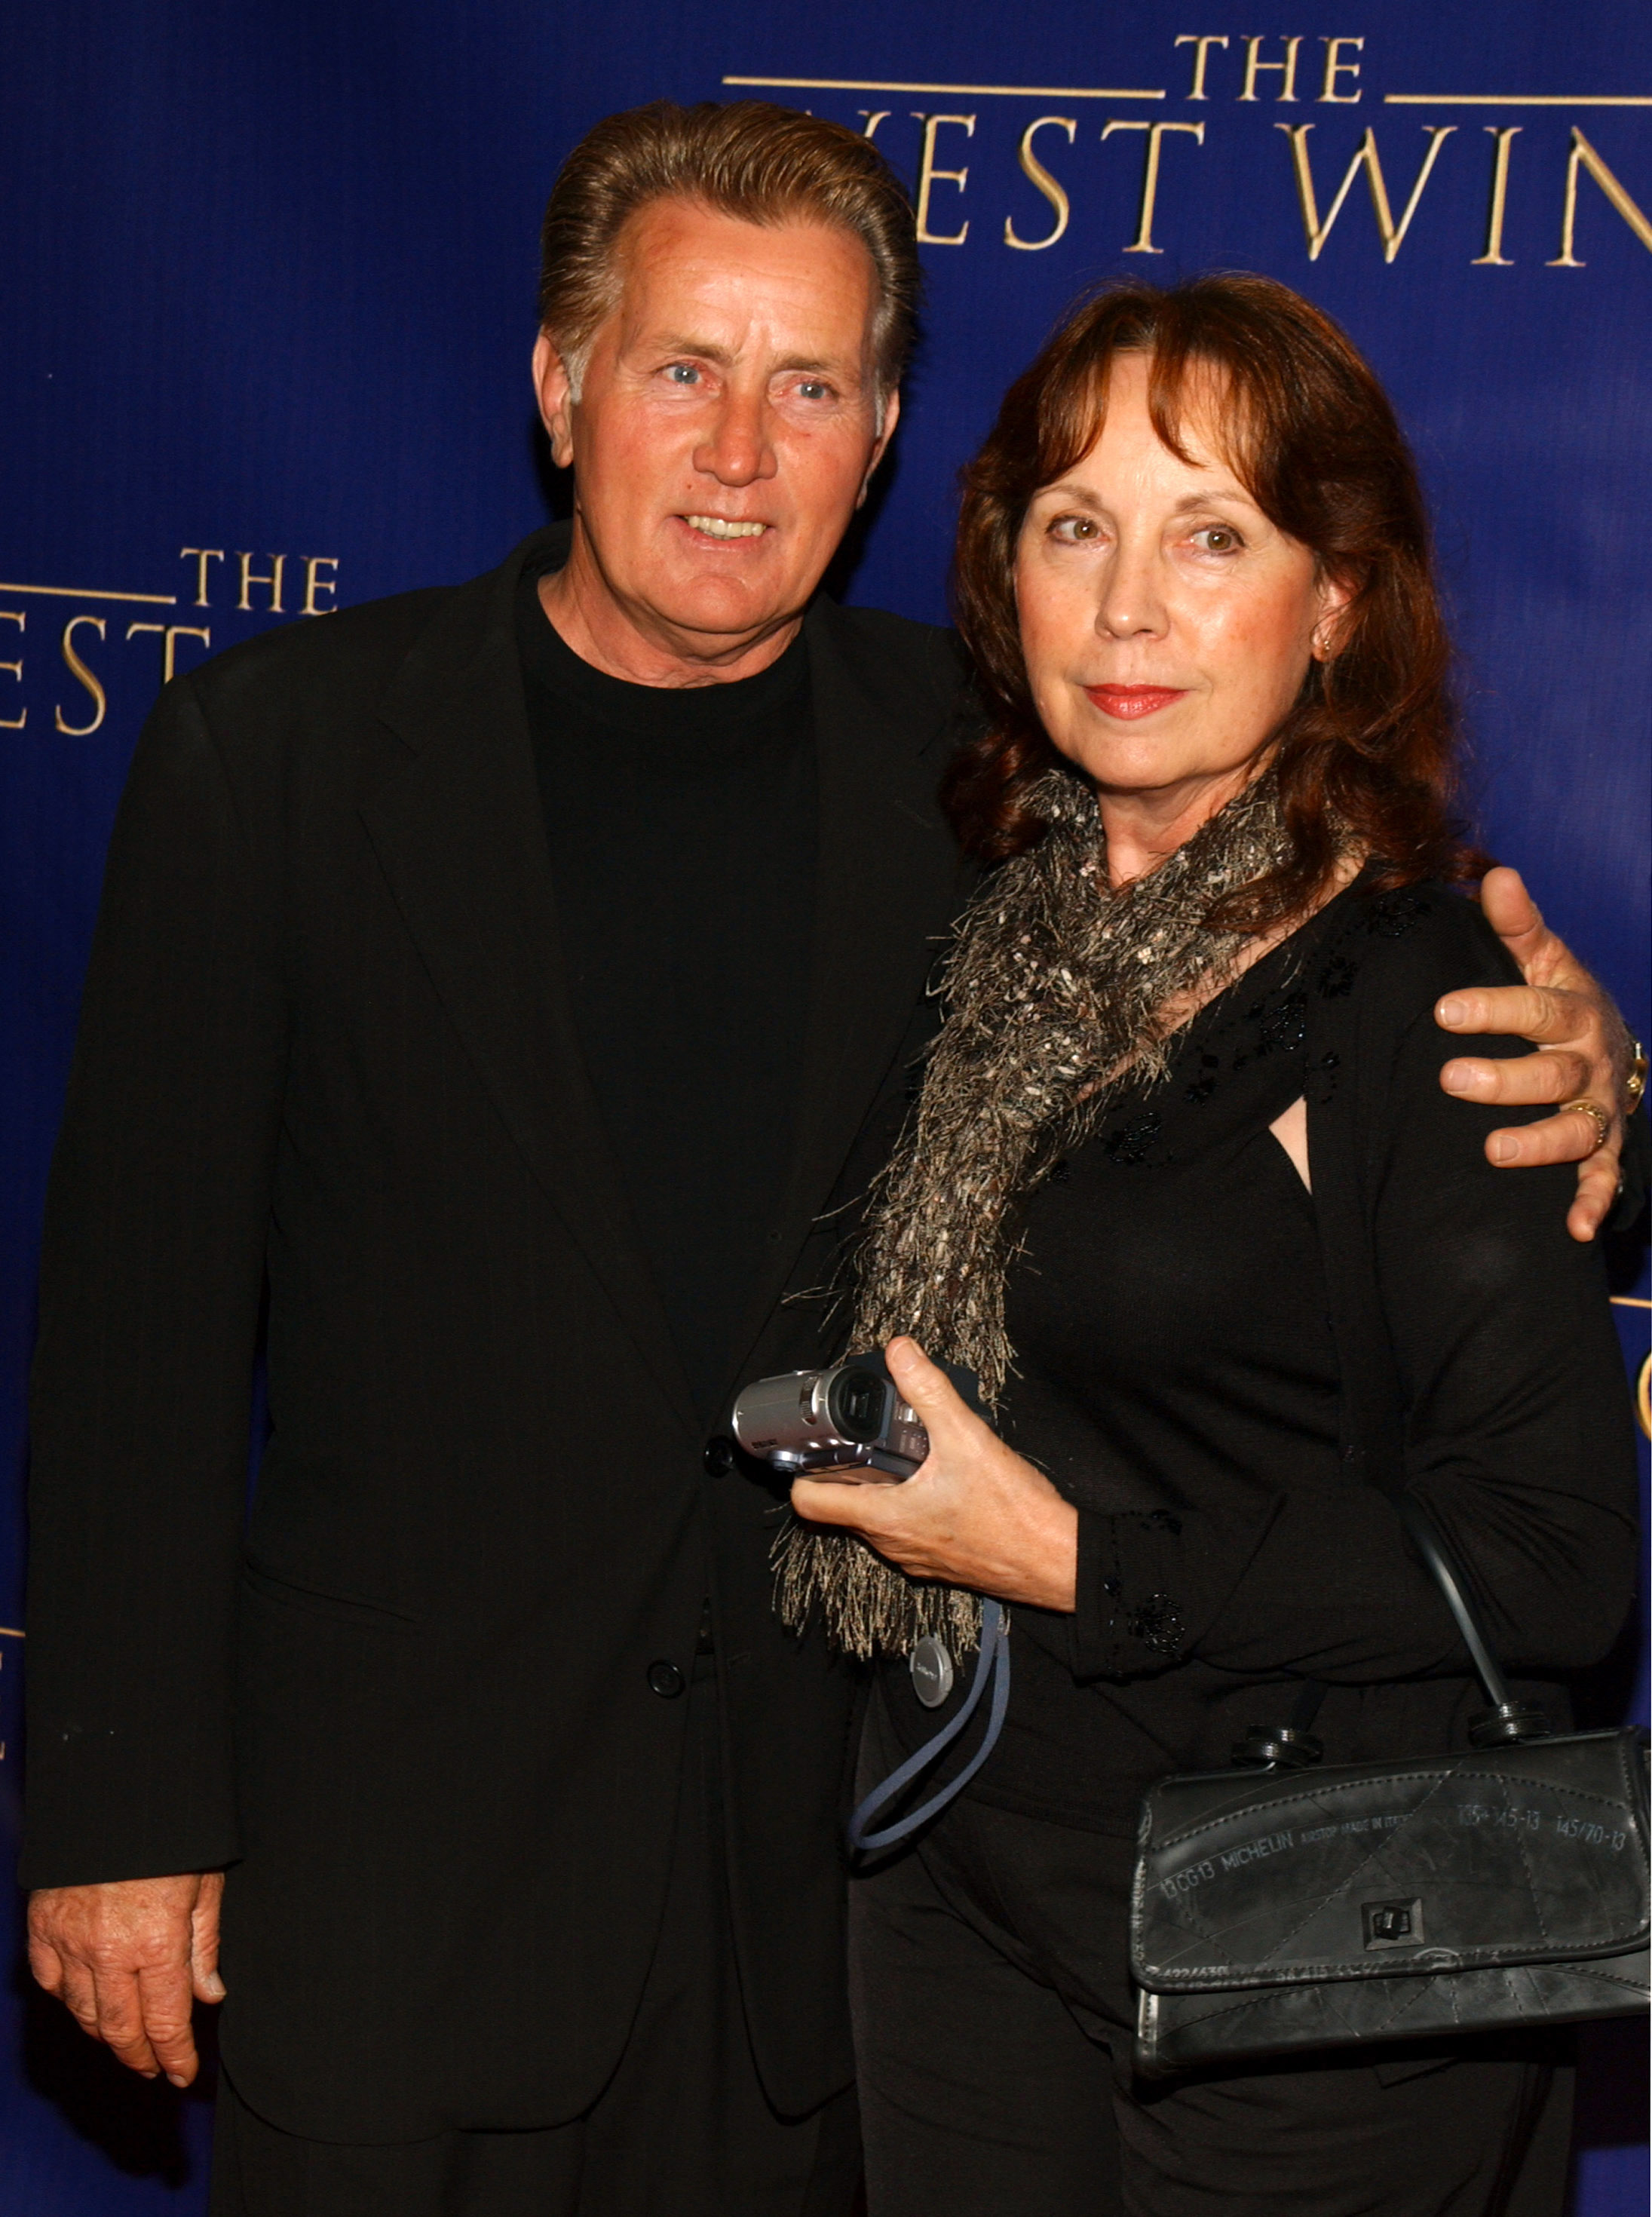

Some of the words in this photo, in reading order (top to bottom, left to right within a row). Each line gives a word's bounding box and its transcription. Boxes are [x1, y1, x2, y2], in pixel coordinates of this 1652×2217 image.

[1174, 35, 1365, 104] THE
[805, 109, 1206, 254] EST
[180, 547, 339, 616] THE
[1221, 1829, 1295, 1872] MICHELIN
[1556, 1815, 1627, 1852] 145/70-13
